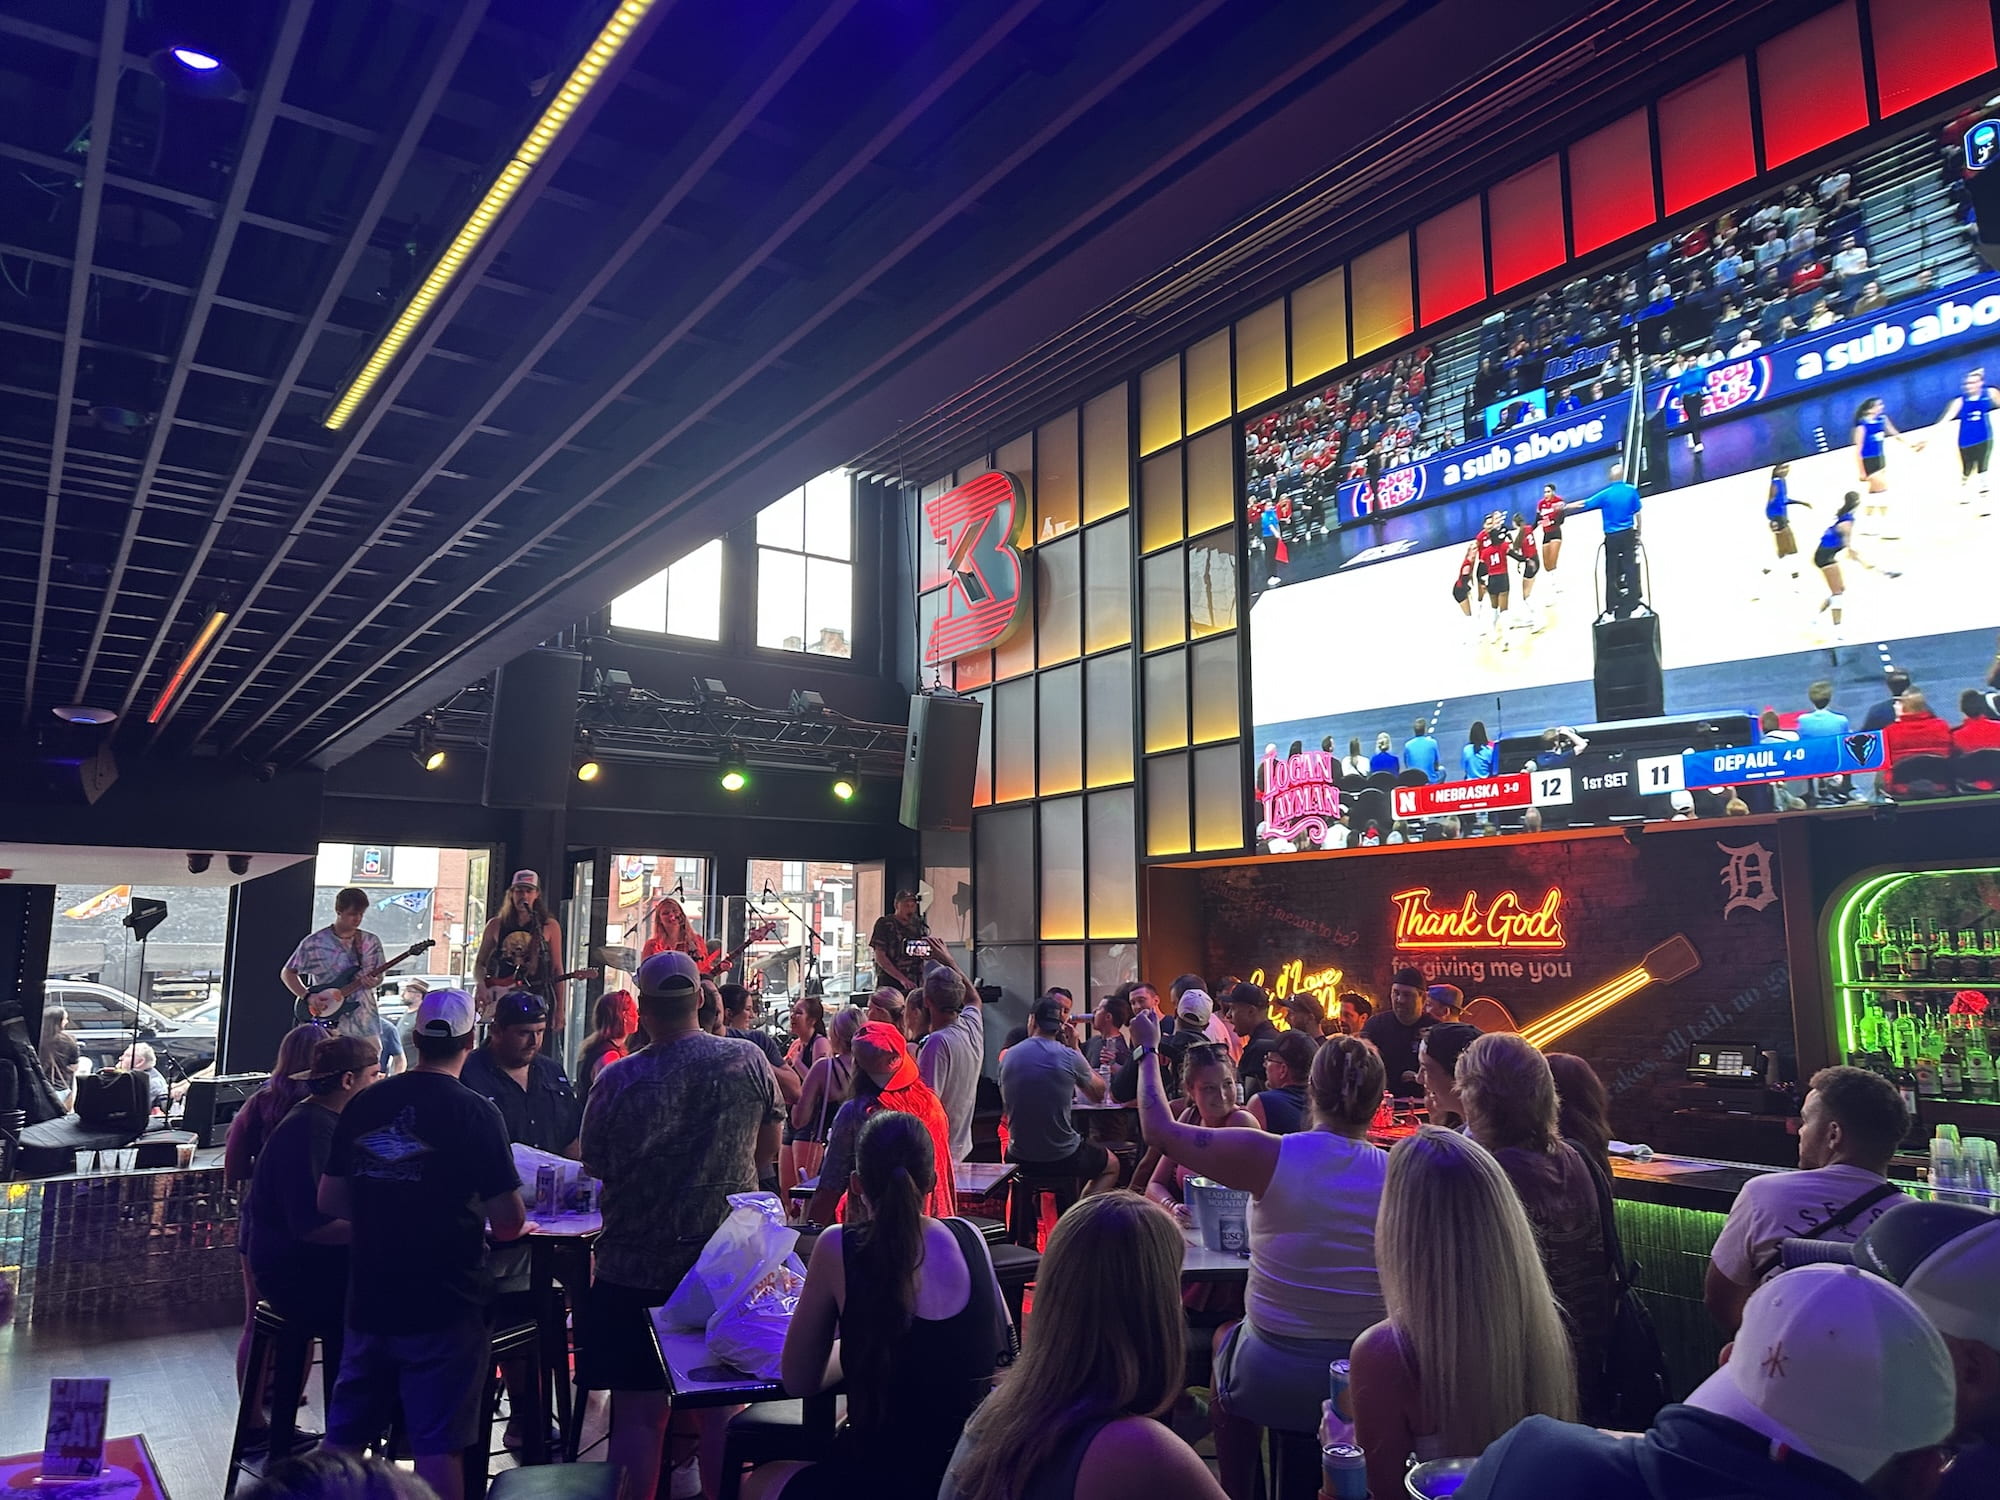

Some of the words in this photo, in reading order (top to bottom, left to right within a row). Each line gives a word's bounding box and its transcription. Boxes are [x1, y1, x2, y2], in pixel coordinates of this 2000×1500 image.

[1795, 352, 1824, 380] a
[1824, 323, 1906, 371] sub
[1444, 464, 1461, 486] a
[1463, 446, 1511, 481] sub
[1513, 419, 1604, 466] above
[1262, 750, 1333, 801] LOGAN
[1604, 771, 1629, 787] SET
[1650, 765, 1671, 786] 11
[1713, 751, 1778, 773] DEPAUL
[1783, 748, 1806, 763] 4-0
[1262, 784, 1341, 844] LAYMAN
[1399, 791, 1417, 813] N
[1435, 783, 1500, 804] NEBRASKA
[1503, 781, 1520, 794] 3-0
[1541, 777, 1562, 798] 12
[1392, 889, 1483, 938] Thank
[1487, 889, 1559, 946] God
[1290, 958, 1344, 995] Love
[1423, 956, 1485, 983] giving
[1490, 960, 1525, 978] me
[1528, 960, 1573, 984] you
[1660, 1029, 1690, 1060] all
[1685, 1003, 1734, 1042] tail,
